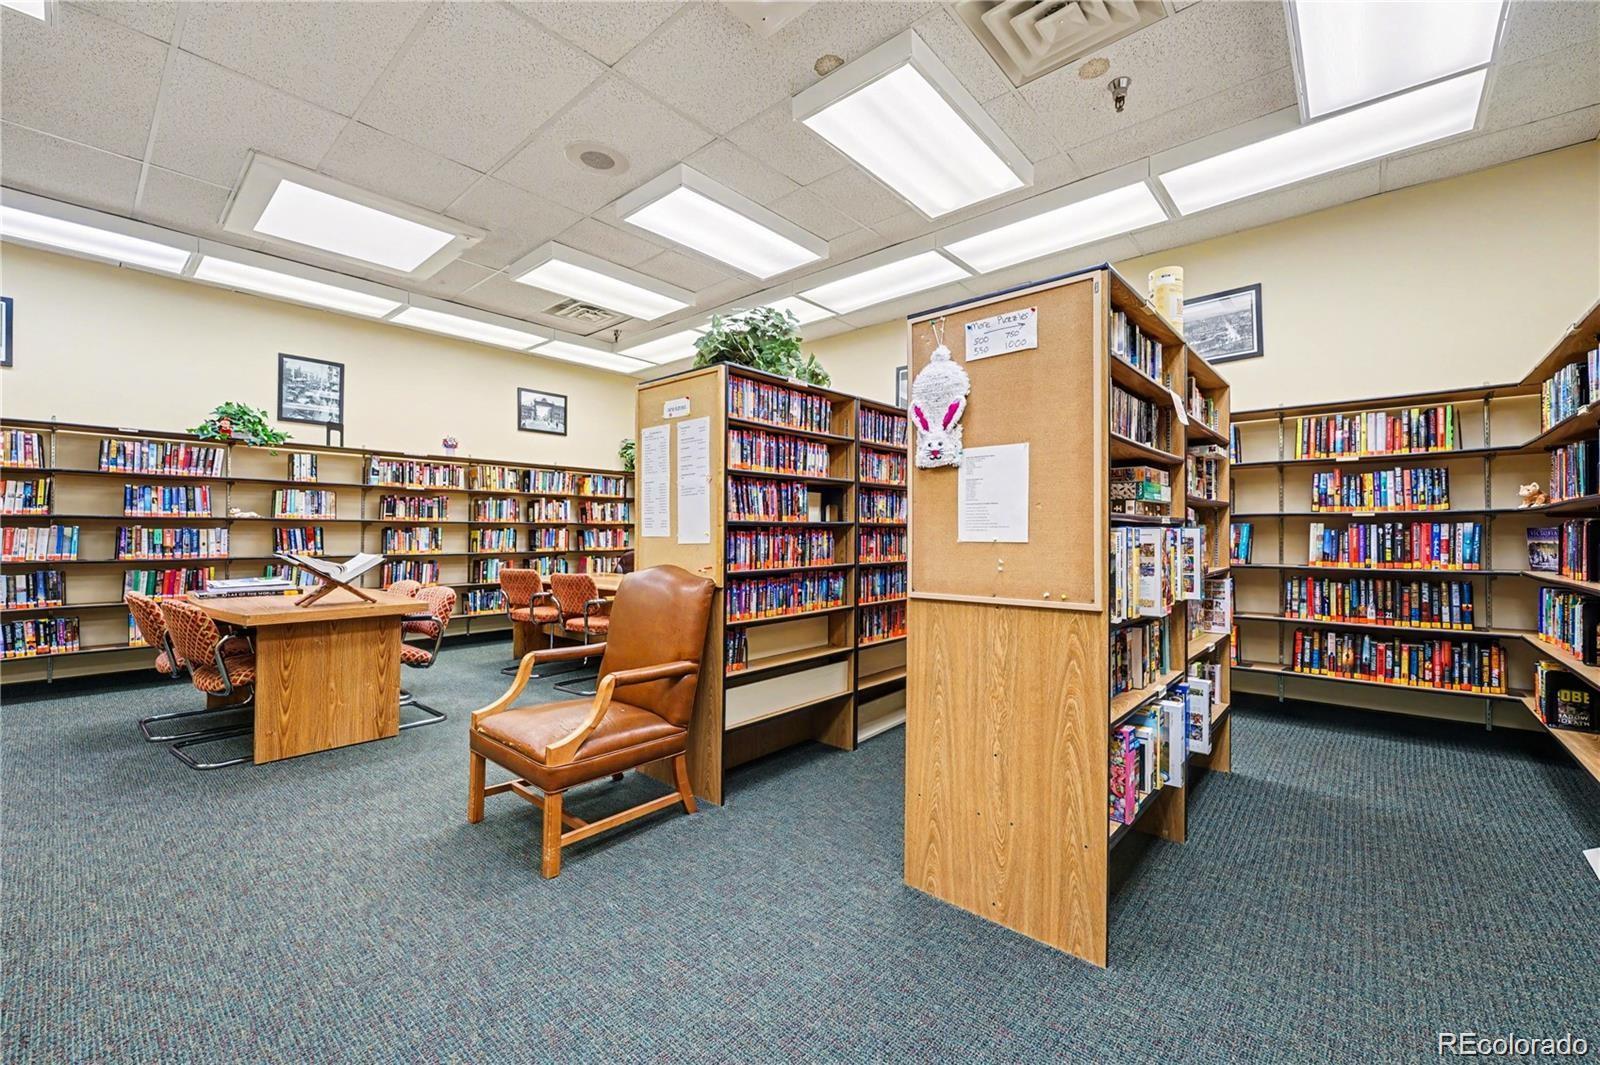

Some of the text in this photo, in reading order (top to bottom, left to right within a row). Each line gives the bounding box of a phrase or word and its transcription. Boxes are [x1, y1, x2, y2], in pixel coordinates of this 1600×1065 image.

[1005, 330, 1019, 338] 750
[974, 336, 989, 346] 500
[1005, 339, 1027, 350] 1000
[974, 346, 989, 355] 550
